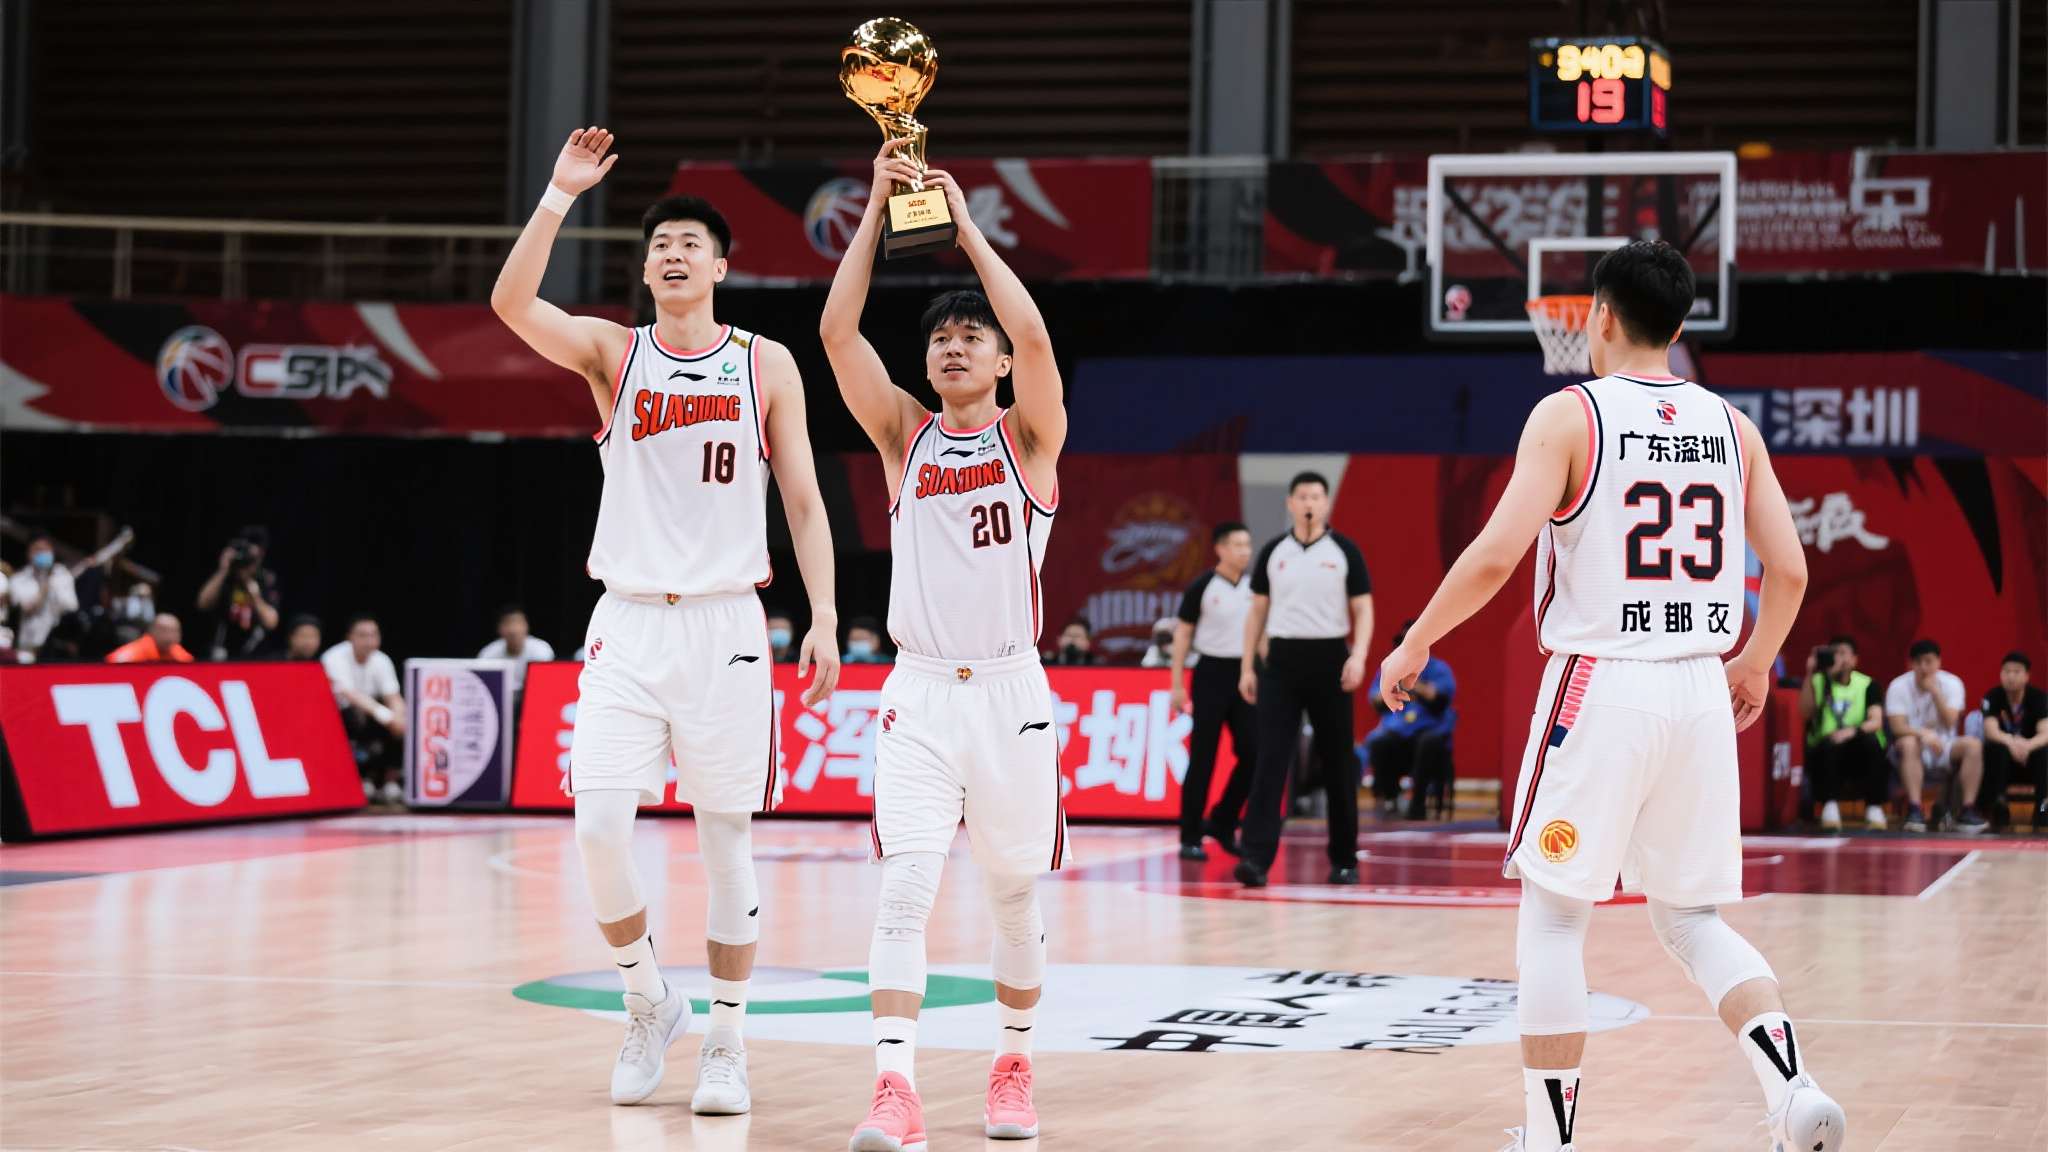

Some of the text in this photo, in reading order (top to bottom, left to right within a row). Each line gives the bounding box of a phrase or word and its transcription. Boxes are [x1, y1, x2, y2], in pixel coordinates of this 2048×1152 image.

[702, 441, 736, 484] 18
[970, 501, 1012, 548] 20
[1624, 481, 1724, 581] 23
[51, 676, 310, 808] TCL
